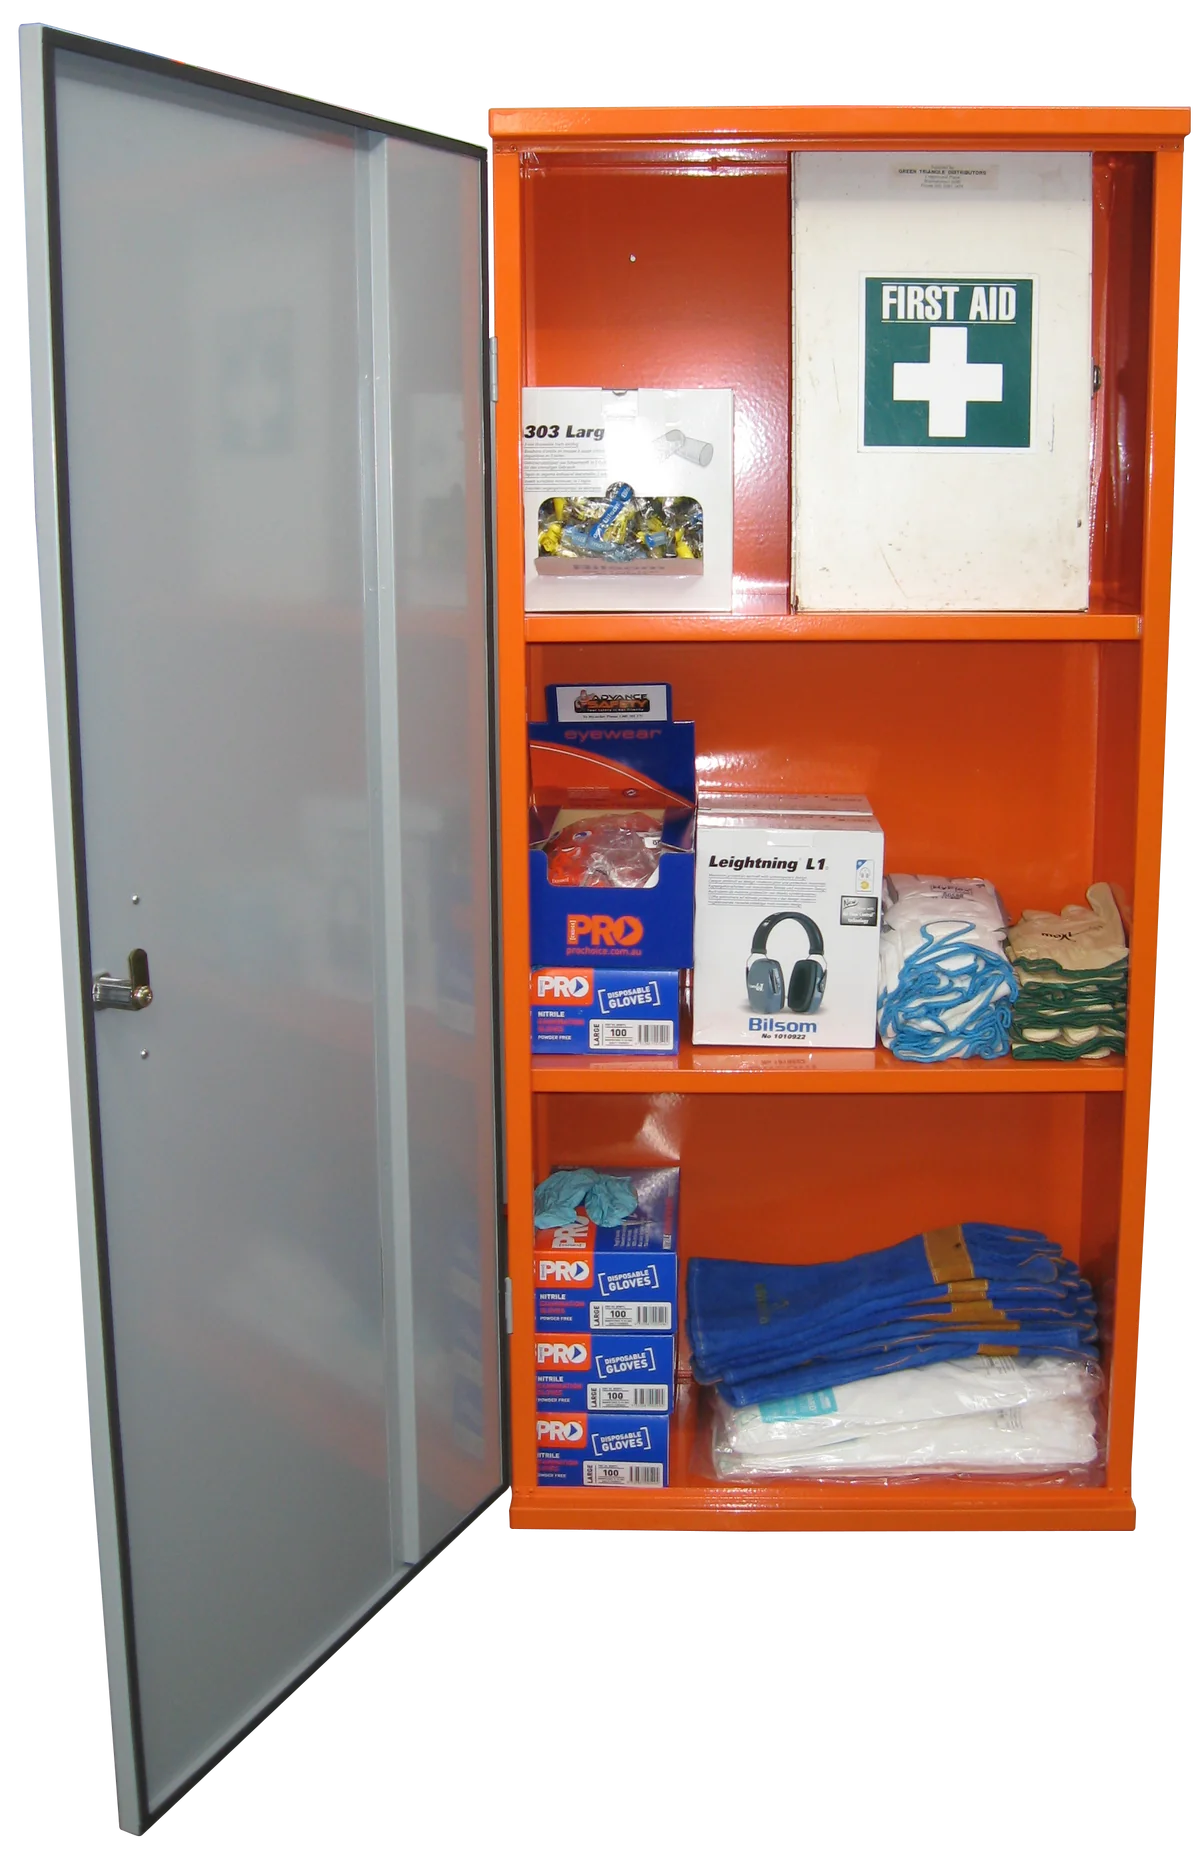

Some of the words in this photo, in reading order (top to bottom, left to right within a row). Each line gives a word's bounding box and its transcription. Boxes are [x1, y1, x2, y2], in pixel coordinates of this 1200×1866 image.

[882, 286, 960, 321] FIRST
[969, 287, 1017, 321] AID
[524, 425, 560, 439] 303
[565, 425, 606, 441] Larg
[587, 700, 649, 708] SAFETY
[592, 693, 648, 701] ADVANCE
[564, 729, 662, 743] eyewear
[708, 855, 798, 873] Leightning
[805, 857, 826, 870] L1
[566, 914, 644, 947] PRO
[566, 947, 642, 957] prochoice.com.au
[537, 975, 590, 998] PRO
[607, 985, 651, 999] DISPOSABLE
[608, 993, 653, 1009] GLOVES
[610, 1028, 627, 1037] 100
[748, 1017, 817, 1033] Bilsom
[539, 1260, 590, 1282] PRO
[606, 1269, 649, 1282] DISPOSABLE
[608, 1276, 652, 1292] GLOVES
[610, 1310, 627, 1318] 100
[537, 1343, 588, 1364] PRO
[604, 1352, 646, 1365] DISPOSABLE
[605, 1359, 649, 1374] GLOVES
[607, 1392, 624, 1400] 100
[536, 1420, 584, 1442] PRO
[600, 1431, 642, 1443] DISPOSABLE
[601, 1437, 644, 1452] GLOVES
[603, 1469, 619, 1477] 100
